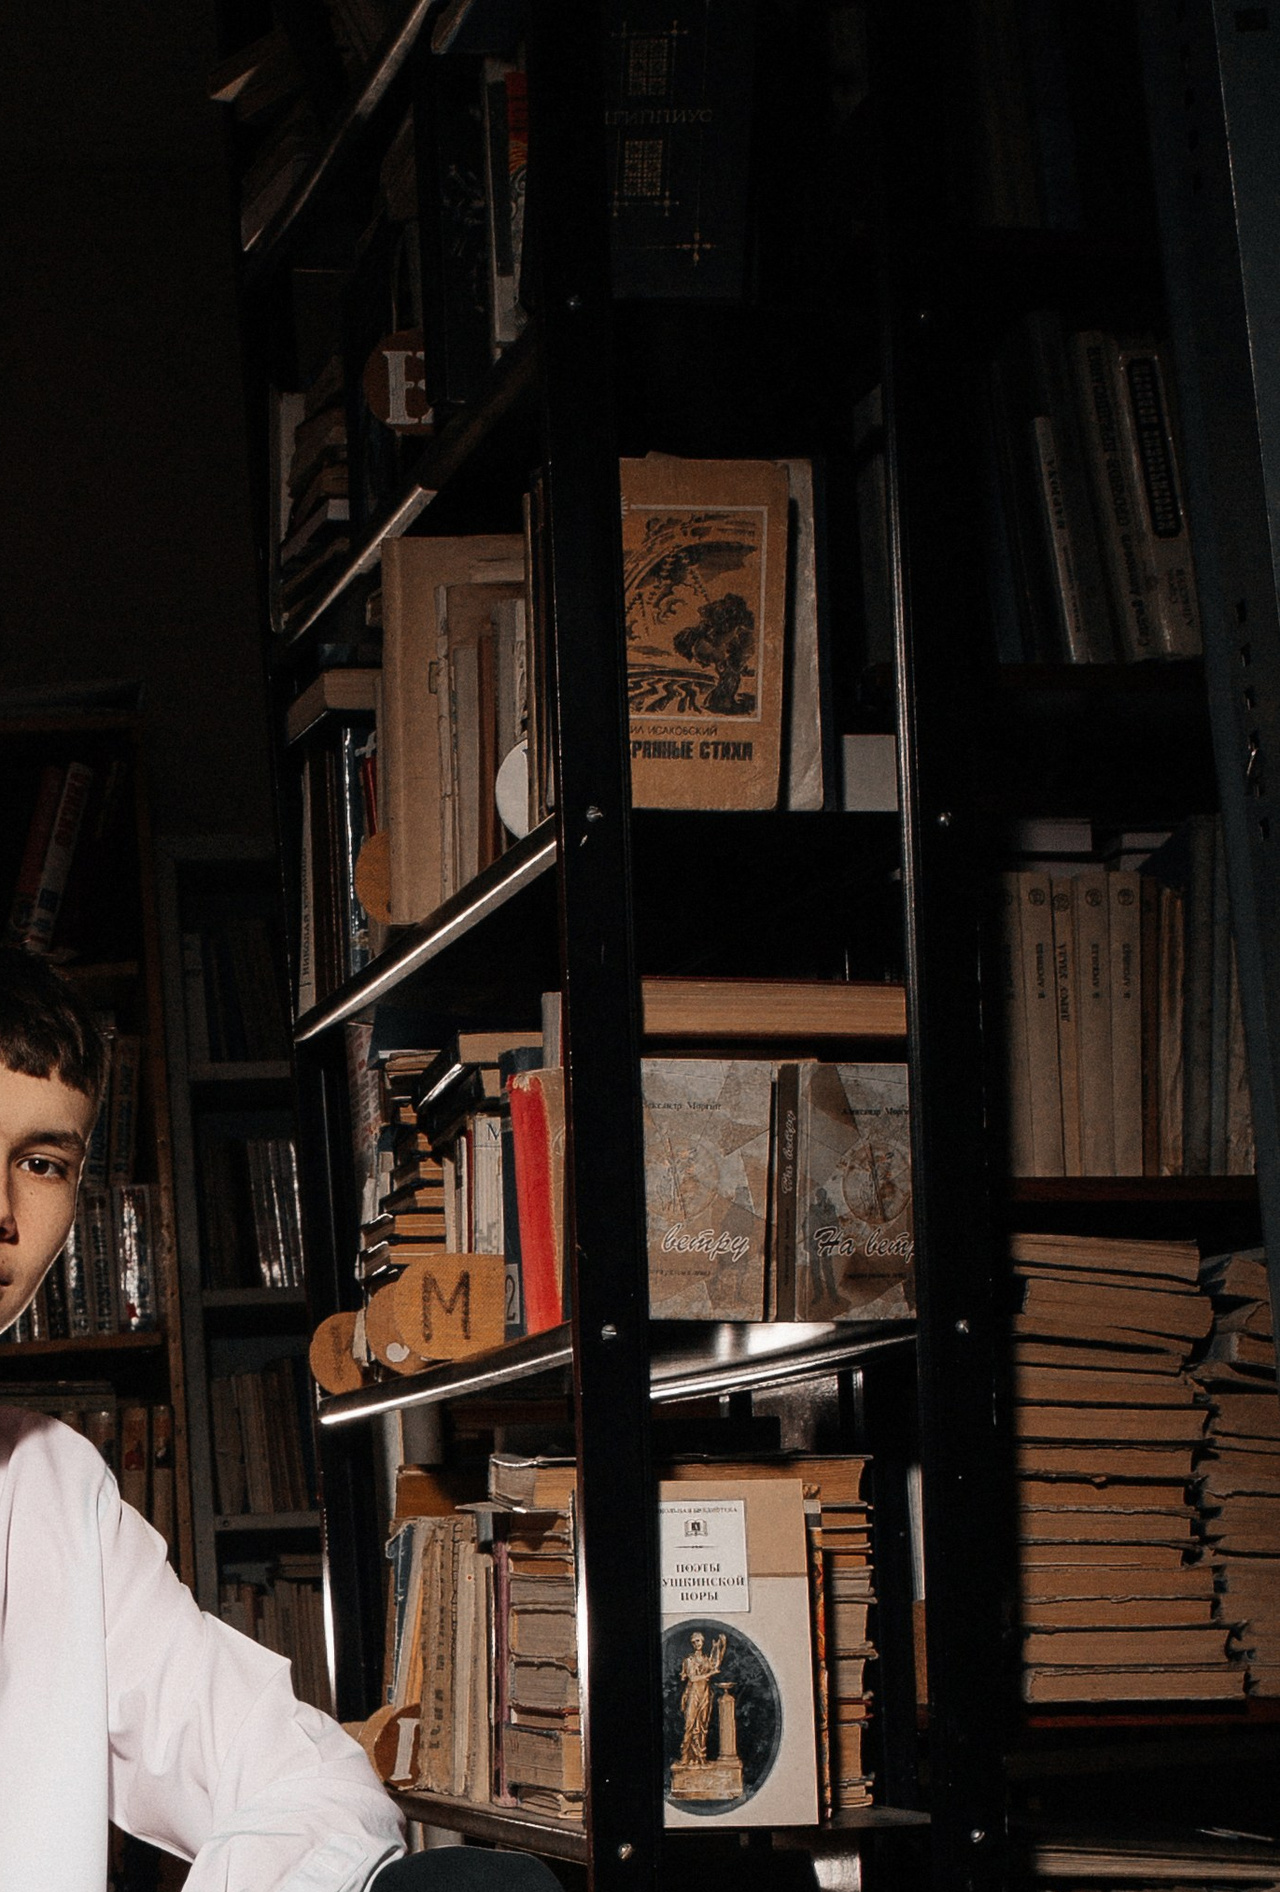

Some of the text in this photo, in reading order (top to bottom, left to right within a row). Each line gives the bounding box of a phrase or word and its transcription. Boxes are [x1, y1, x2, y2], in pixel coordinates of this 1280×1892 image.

[648, 725, 719, 737] ИСАКОВСКИЙ
[631, 740, 753, 761] РАННЫЕ СТИХИ
[661, 1222, 750, 1263] ветру
[813, 1225, 857, 1258] На
[421, 1268, 472, 1343] М
[676, 1563, 720, 1573] ПОЭТЫ
[662, 1576, 745, 1587] УШКИНСКОЙ
[680, 1591, 719, 1601] ПОРЫ
